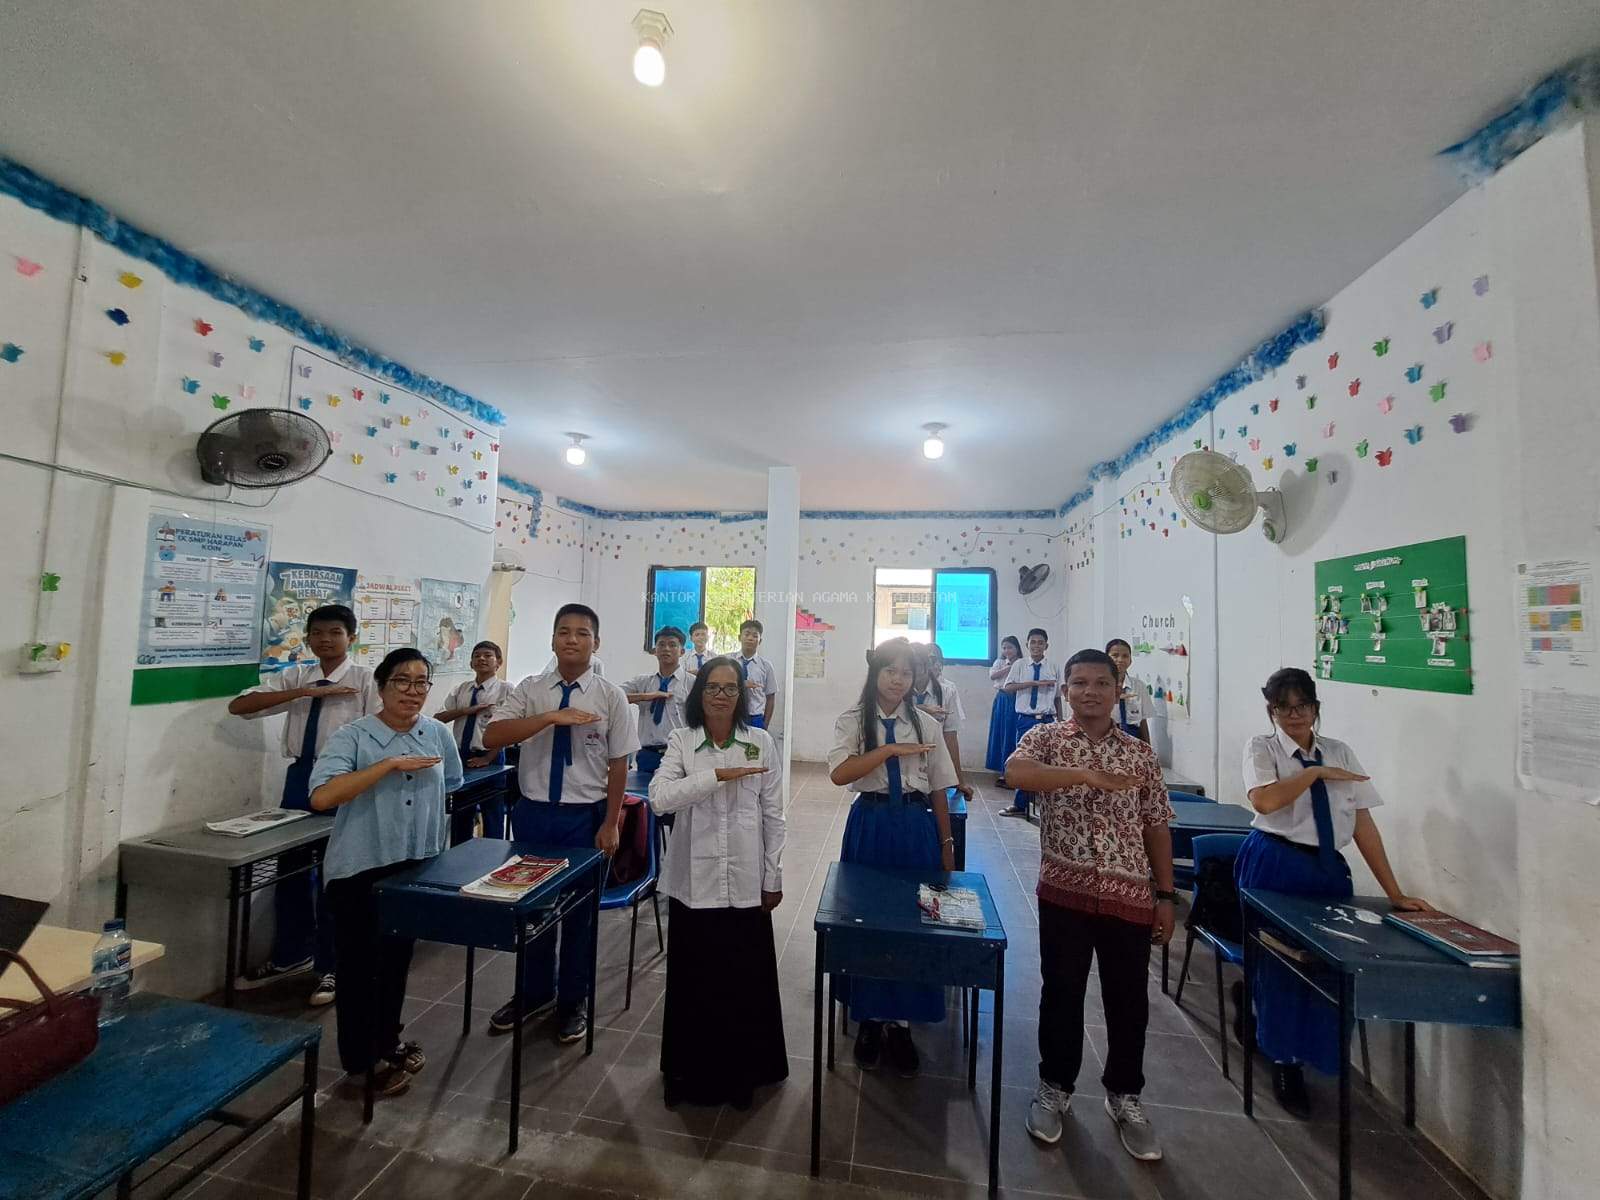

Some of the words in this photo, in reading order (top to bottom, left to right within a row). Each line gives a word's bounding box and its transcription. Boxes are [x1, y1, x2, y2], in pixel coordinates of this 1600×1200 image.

[176, 528, 222, 541] PERATURAN
[207, 538, 244, 549] HARAPAN
[290, 569, 344, 584] KEBIASAAN
[290, 579, 319, 590] ANAK
[297, 588, 328, 600] HEBAT
[1142, 613, 1175, 628] Church
